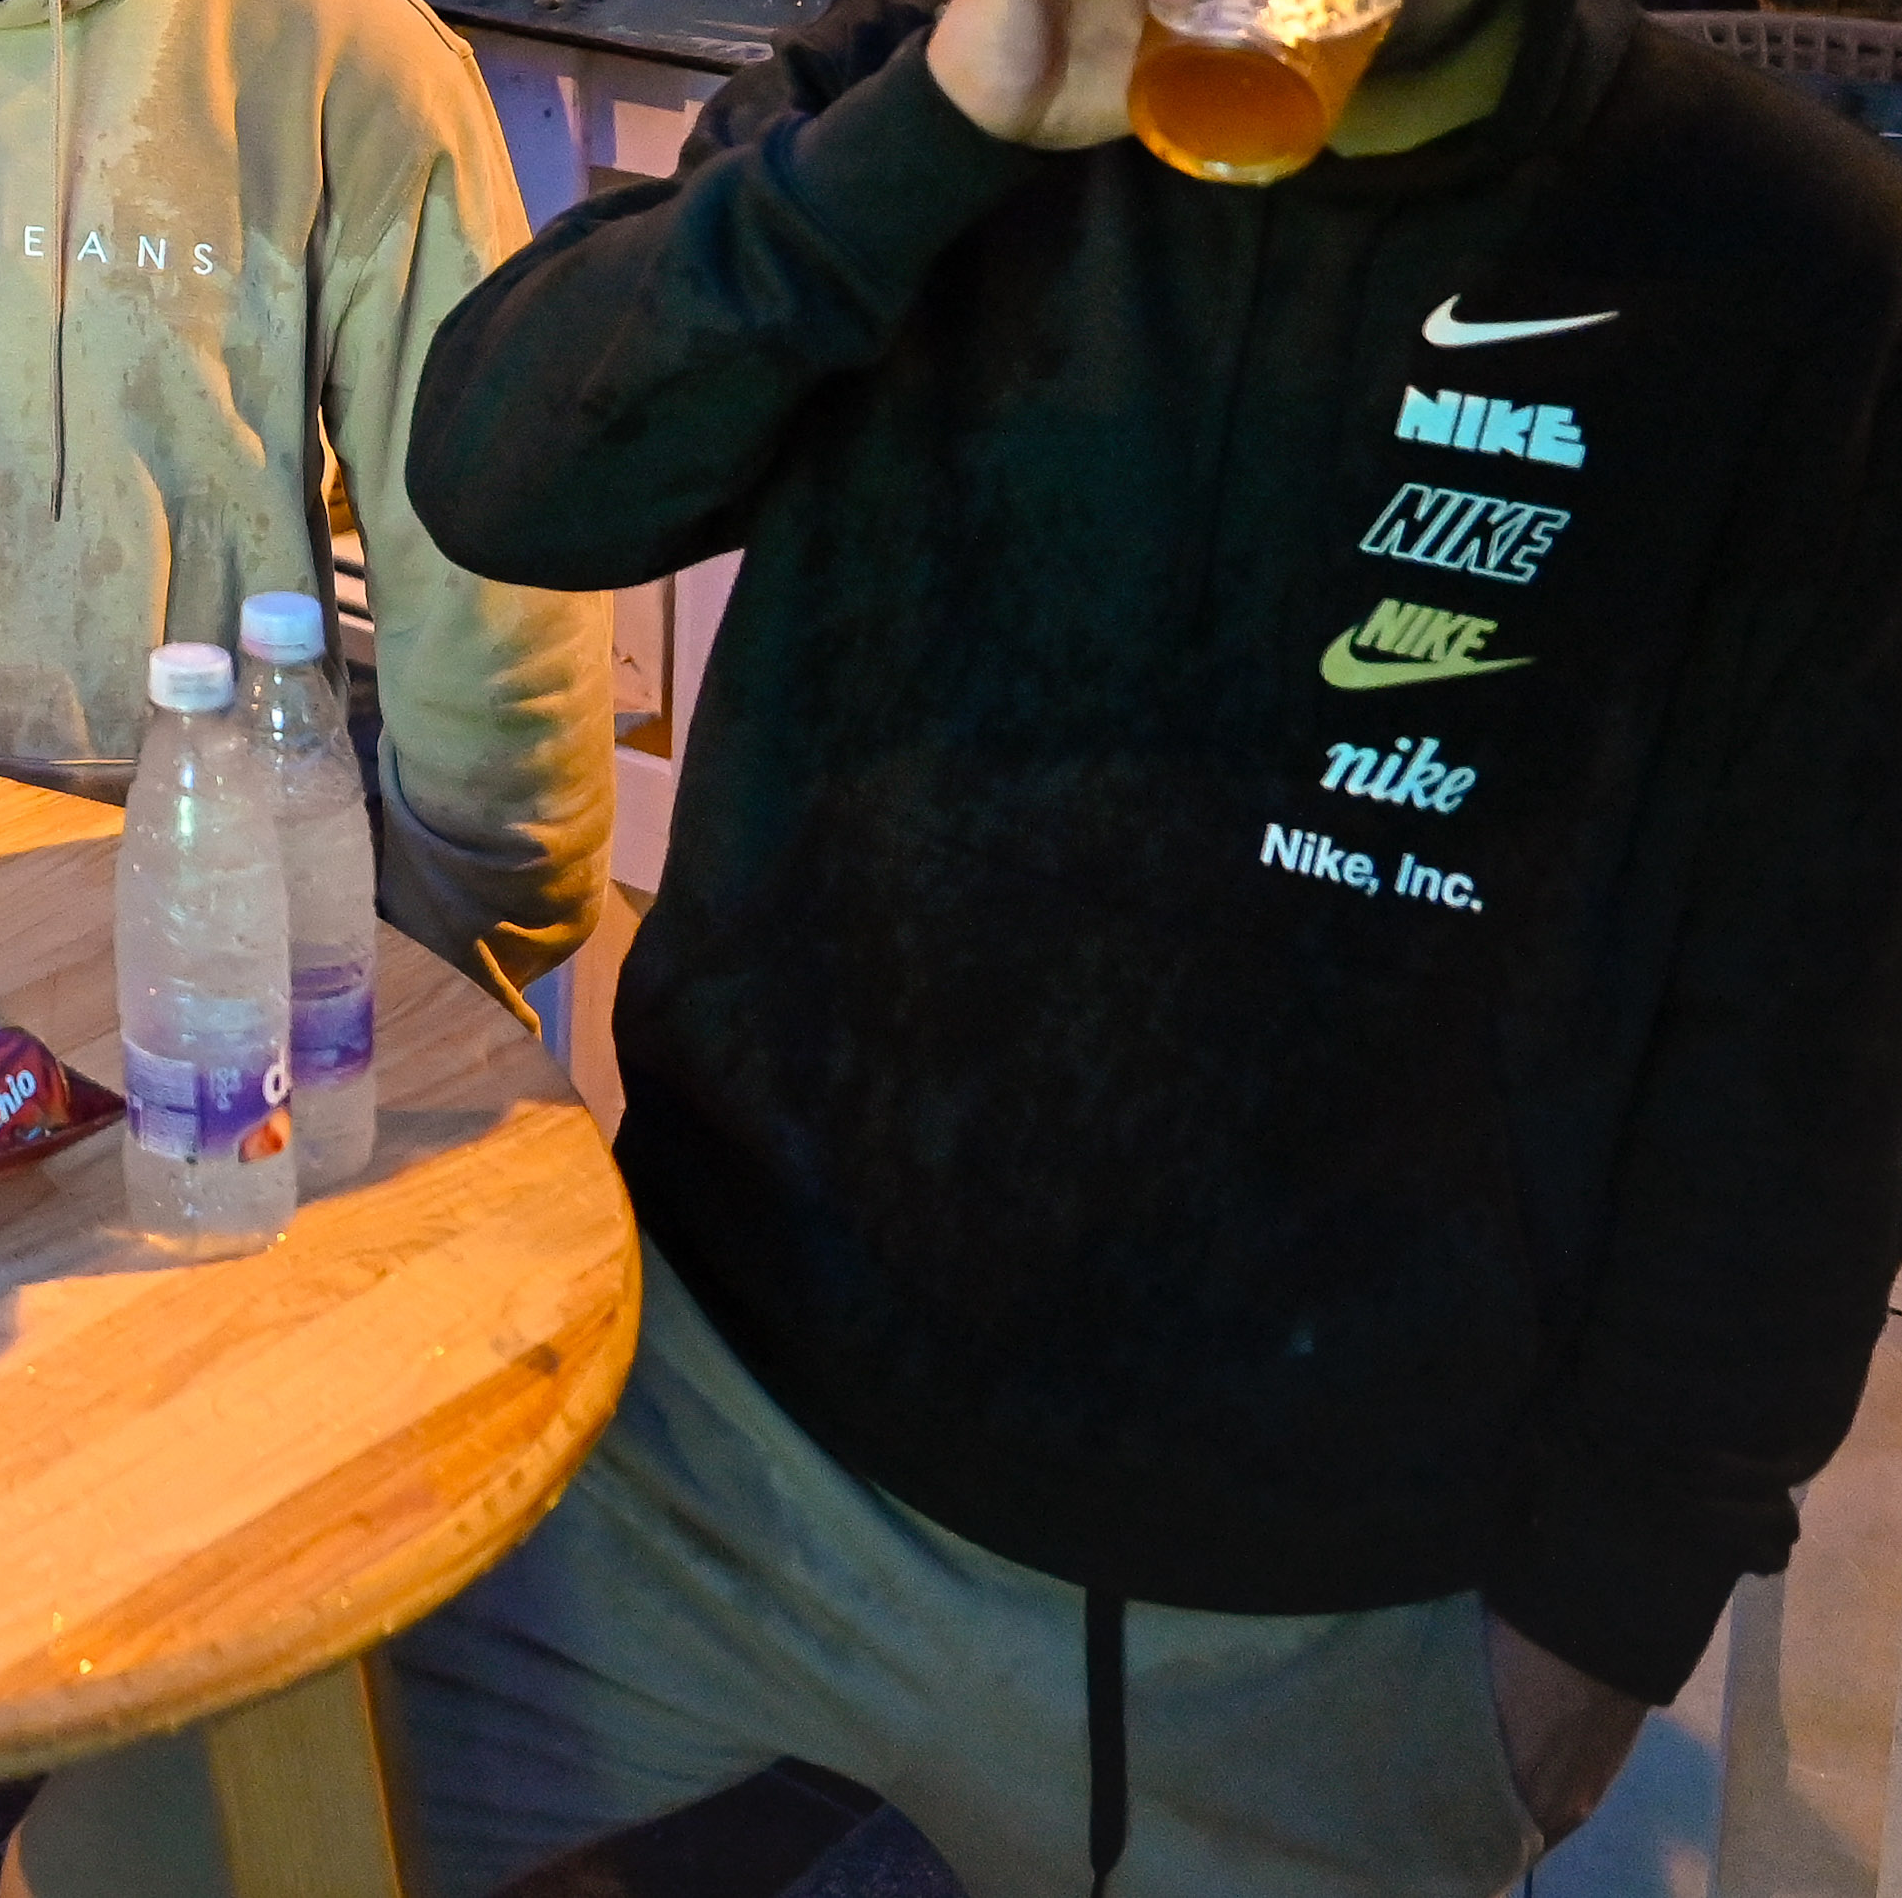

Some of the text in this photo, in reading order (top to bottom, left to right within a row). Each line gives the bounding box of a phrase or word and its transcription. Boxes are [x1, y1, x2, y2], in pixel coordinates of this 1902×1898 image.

[1396, 385, 1586, 468] NIKE
[1360, 482, 1571, 584] NIKE
[1356, 598, 1498, 664] NIKE
[1320, 737, 1477, 814] nike
[1260, 822, 1484, 914] Nike, Inc.
